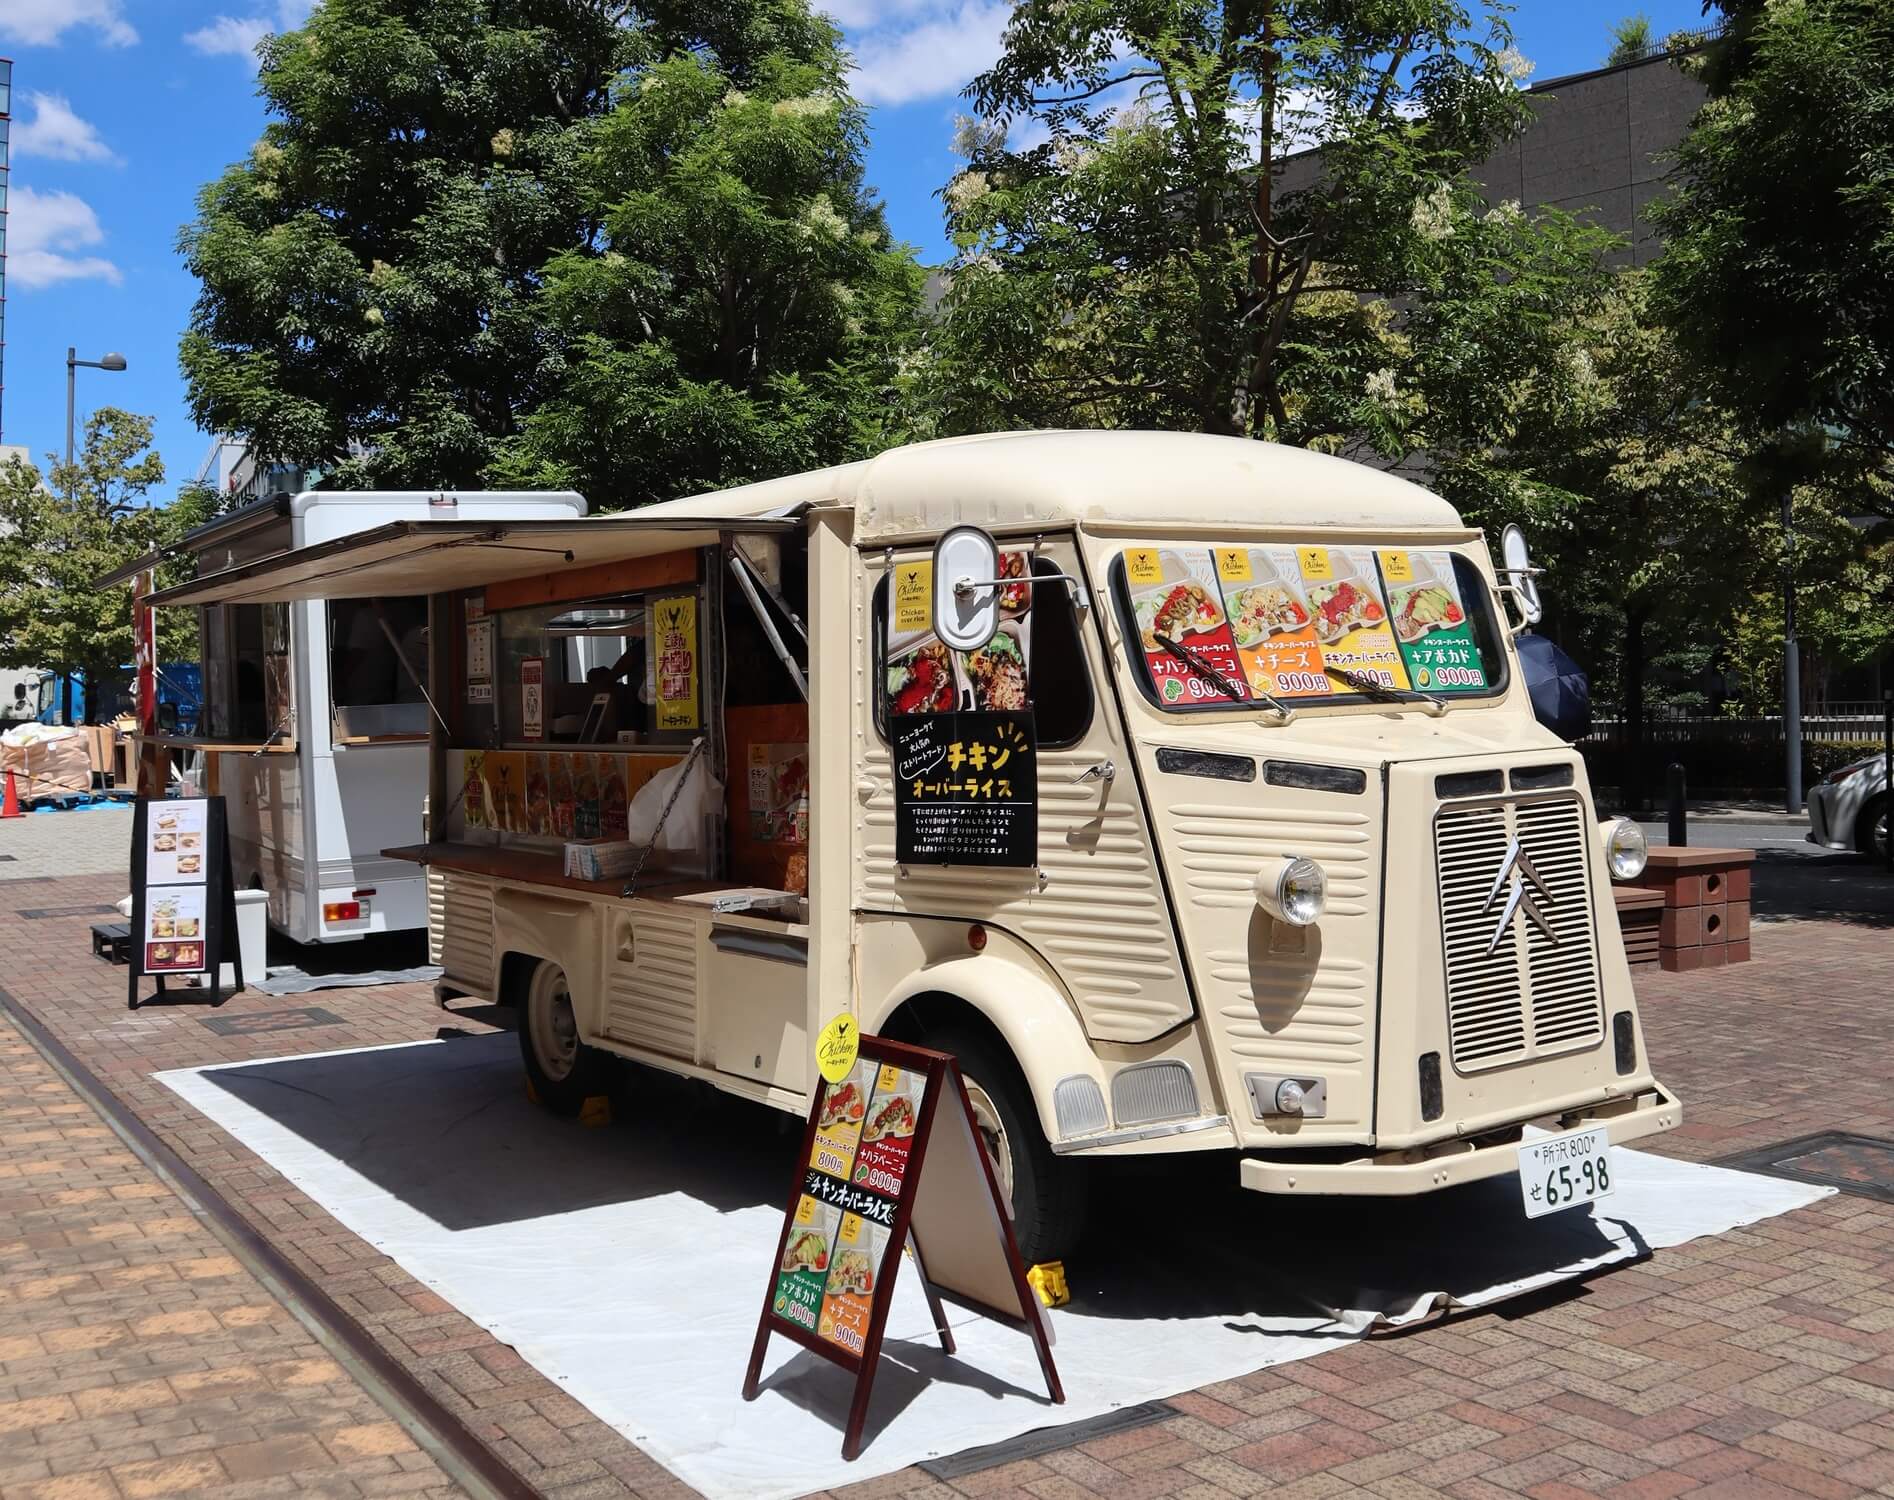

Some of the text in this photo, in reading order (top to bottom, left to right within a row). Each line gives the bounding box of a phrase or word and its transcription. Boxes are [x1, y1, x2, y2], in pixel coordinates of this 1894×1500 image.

[897, 583, 926, 598] Chicken
[1185, 644, 1231, 653] オーバーライス
[1255, 652, 1310, 669] +チーズ
[1325, 652, 1400, 665] チキンオーバーライス
[1412, 649, 1471, 664] +アボカド
[658, 651, 691, 675] 大盛り
[1153, 657, 1236, 674] +ハラニョ
[1187, 677, 1245, 697] 90円
[1277, 672, 1329, 692] 900円
[1436, 667, 1484, 686] 900円
[903, 745, 942, 769] ストリートフード
[909, 738, 931, 753] 大人気の
[947, 741, 1010, 771] チキン
[913, 778, 1012, 798] オーバーライス
[819, 1039, 856, 1059] Chicken
[860, 1148, 905, 1174] +ハラペーニョ
[1542, 1135, 1591, 1165] 所沢 800
[817, 1150, 844, 1175] 800円
[869, 1168, 902, 1196] 900円
[1530, 1156, 1610, 1206] せ 65-98
[811, 1175, 891, 1225] チキンオーバーライス
[782, 1279, 817, 1306] +アボカド
[788, 1300, 816, 1329] 900円
[829, 1303, 862, 1327] +チーズ
[834, 1322, 864, 1353] 900円
